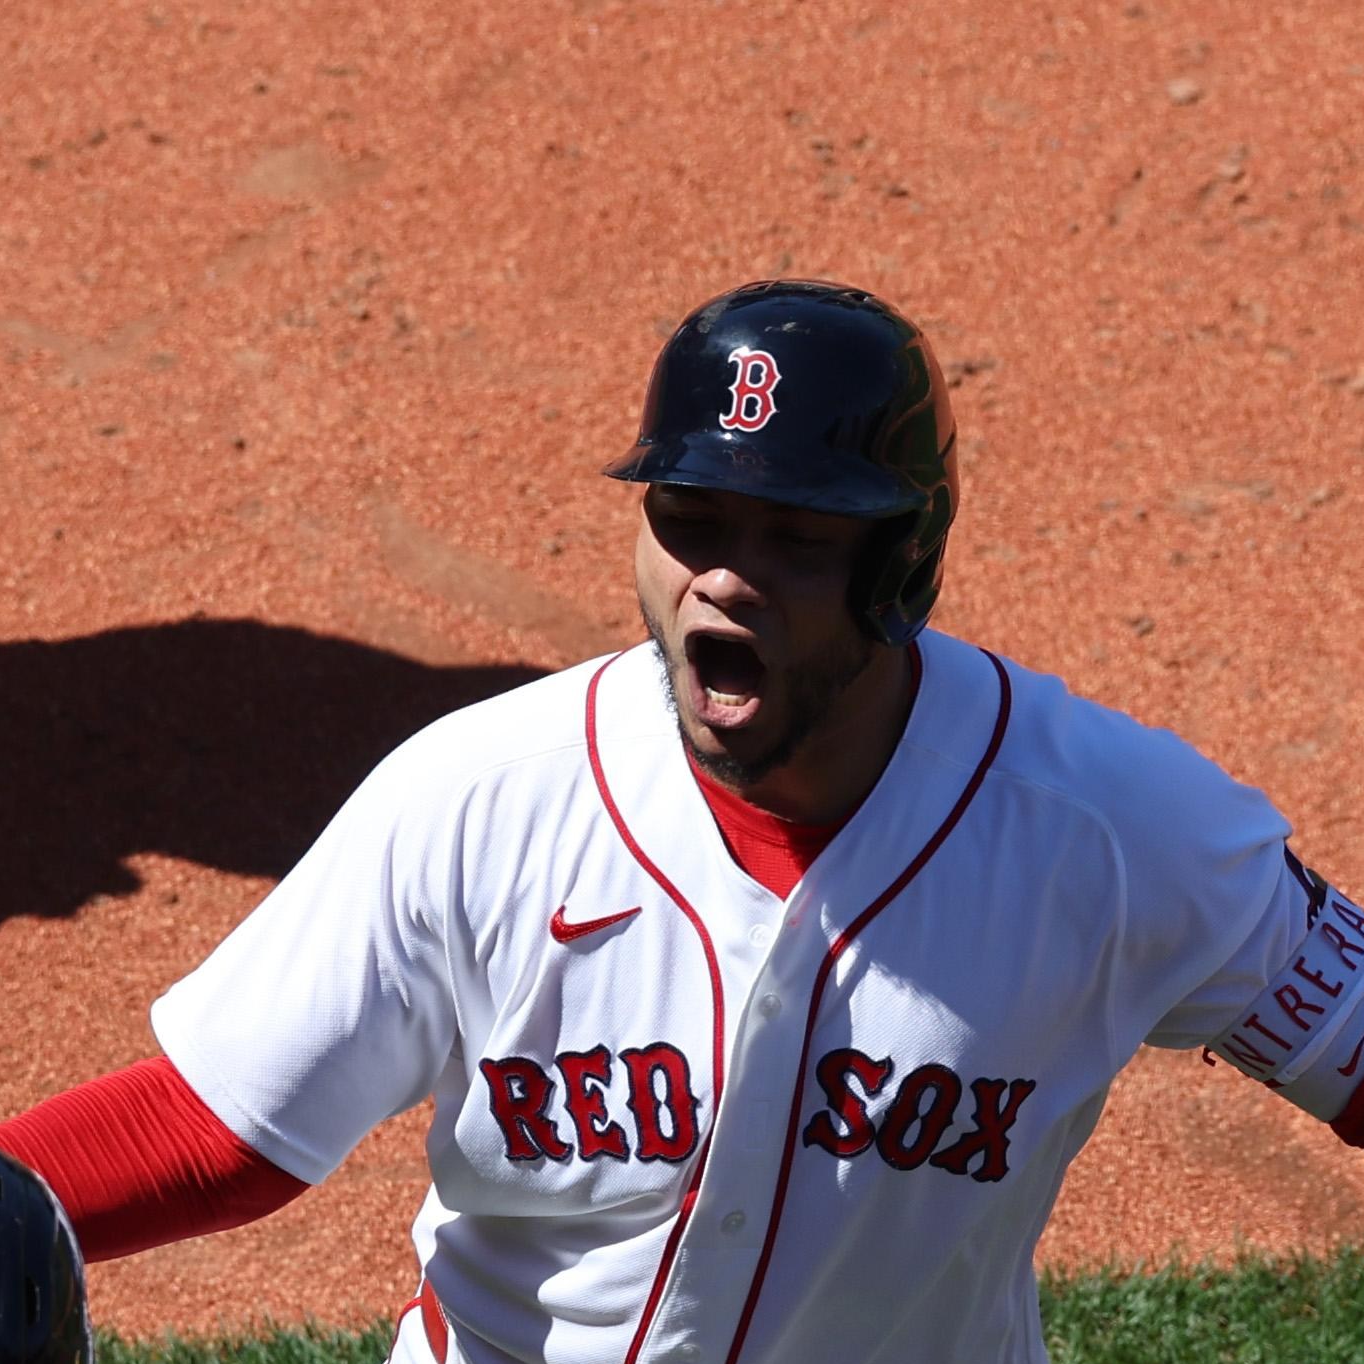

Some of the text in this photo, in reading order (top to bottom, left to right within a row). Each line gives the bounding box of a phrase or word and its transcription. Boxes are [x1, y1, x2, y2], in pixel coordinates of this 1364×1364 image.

[719, 350, 782, 432] B
[479, 1041, 1036, 1183] RED SOX
